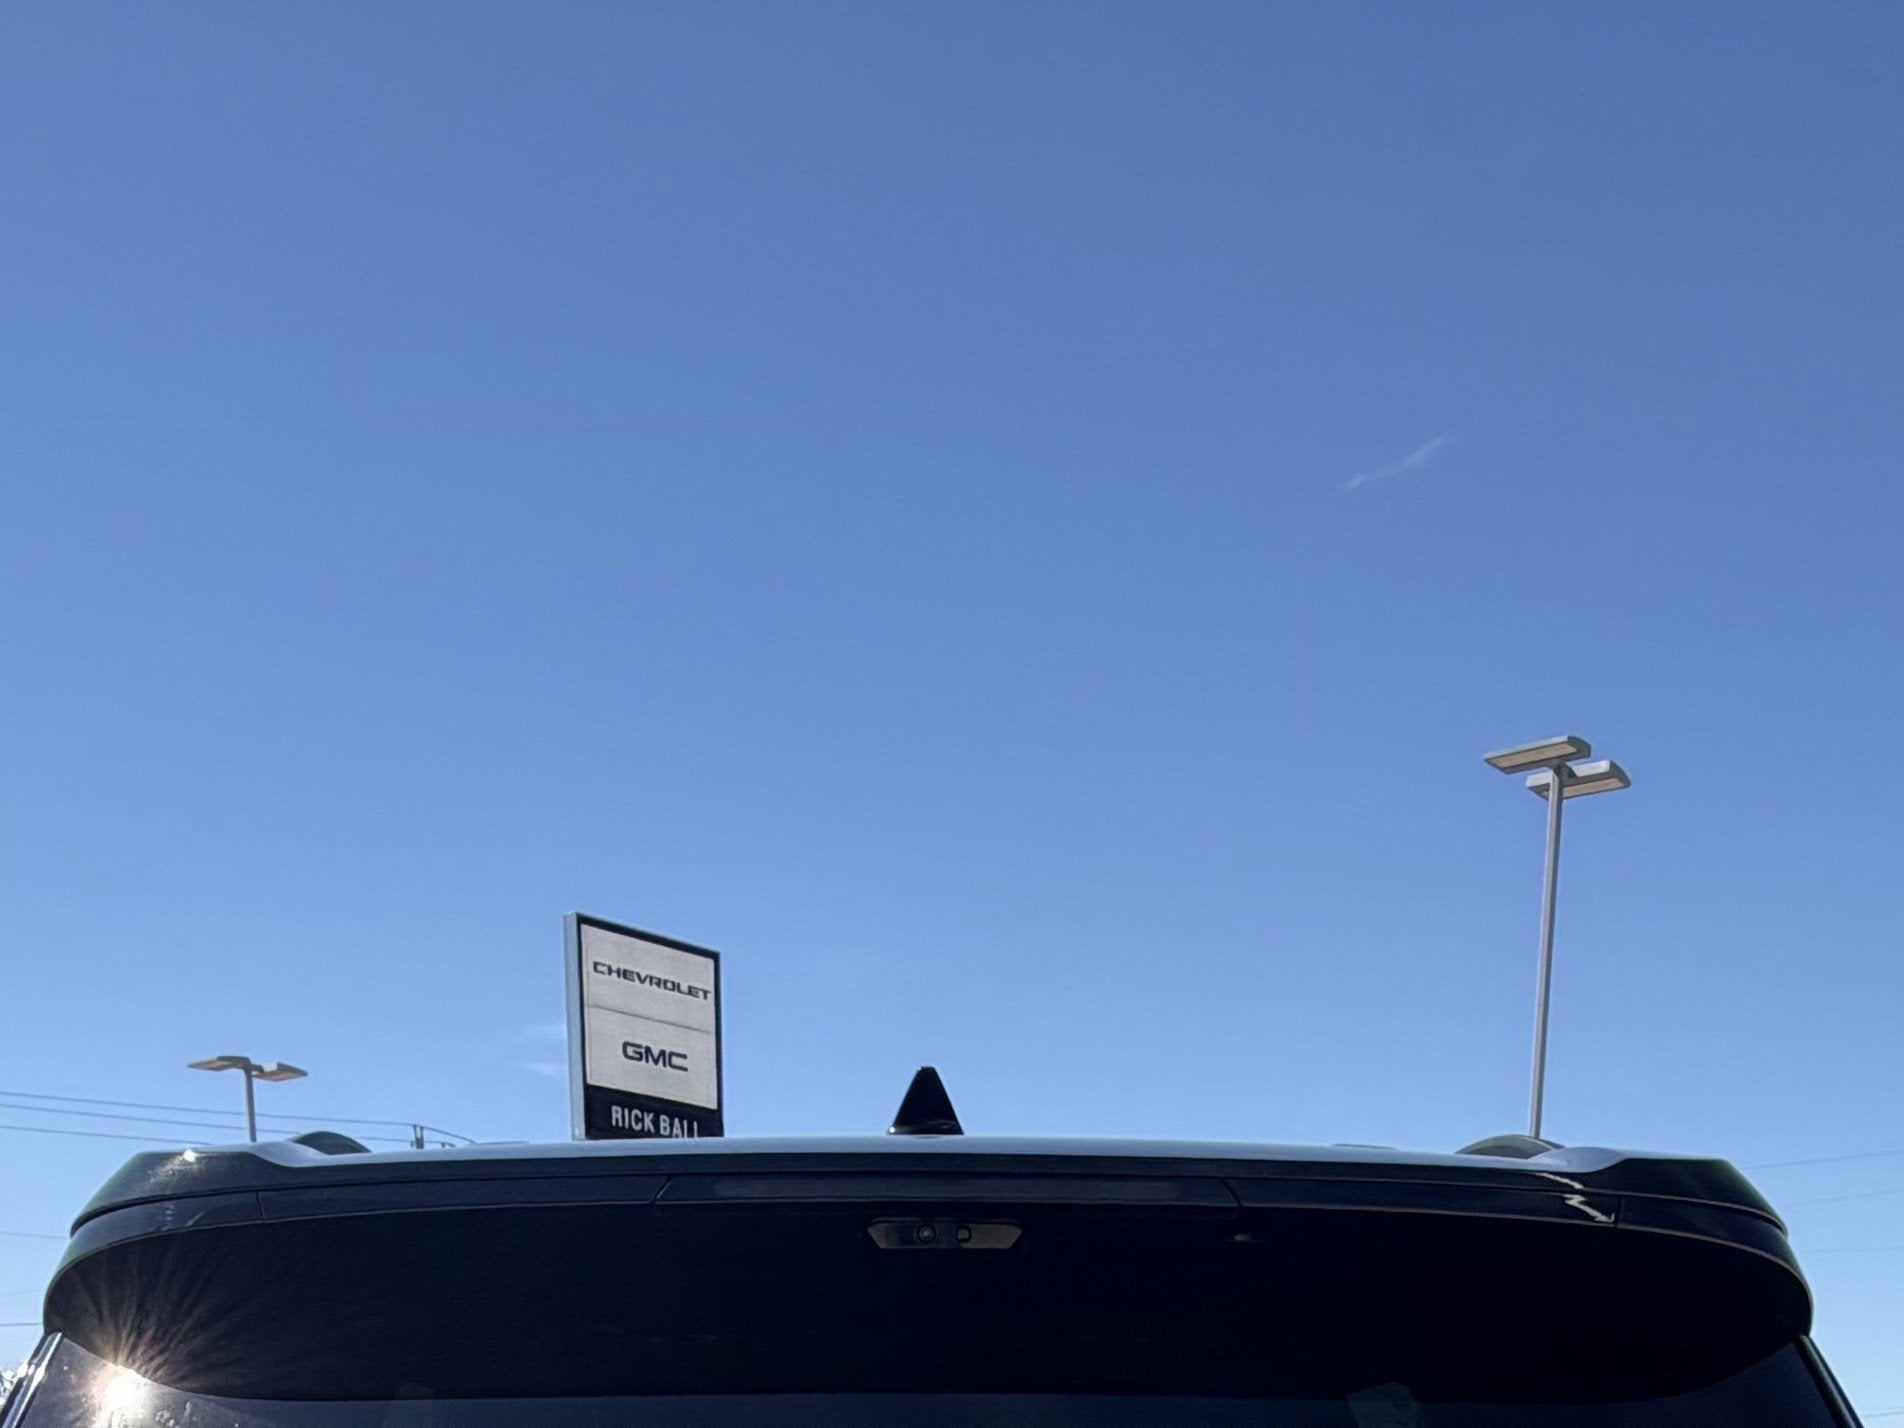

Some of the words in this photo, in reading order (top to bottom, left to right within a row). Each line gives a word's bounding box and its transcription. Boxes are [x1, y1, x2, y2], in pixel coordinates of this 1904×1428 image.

[592, 961, 711, 1000] CHEVROLET
[622, 1041, 688, 1072] GMC
[611, 1105, 656, 1133] RICK
